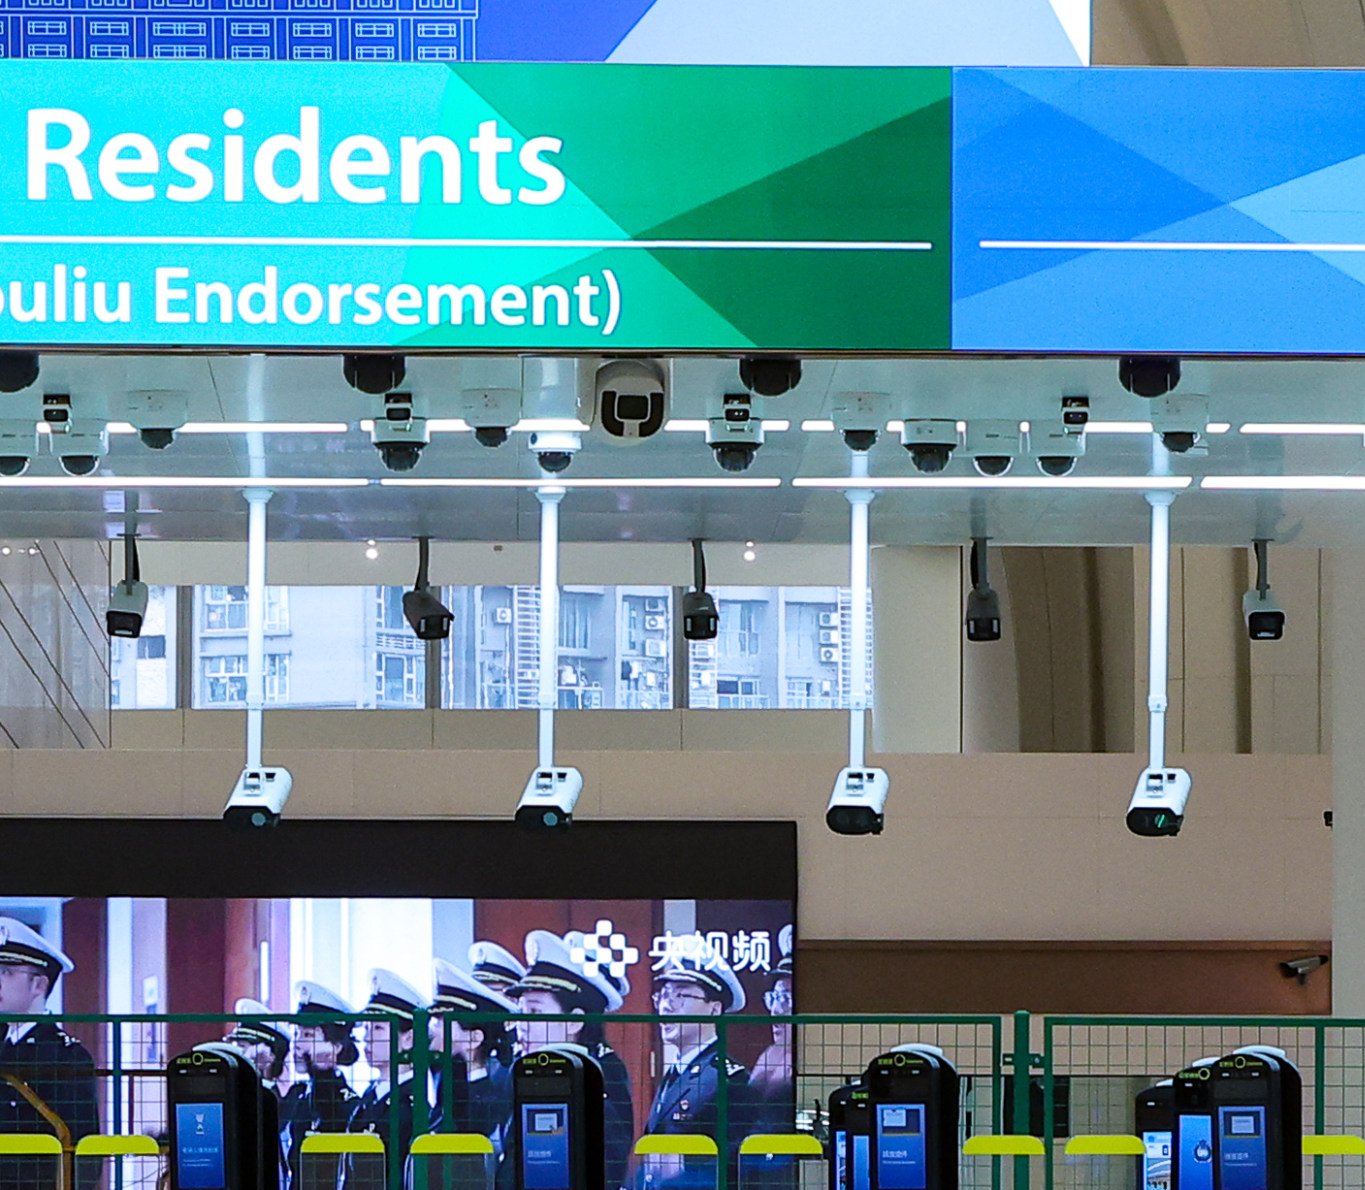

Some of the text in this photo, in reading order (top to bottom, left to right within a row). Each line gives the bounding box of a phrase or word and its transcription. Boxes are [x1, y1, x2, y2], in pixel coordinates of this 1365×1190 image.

[28, 106, 565, 205] Residents
[0, 264, 620, 335] uliu Endorsement)
[648, 930, 771, 972] 央视频
